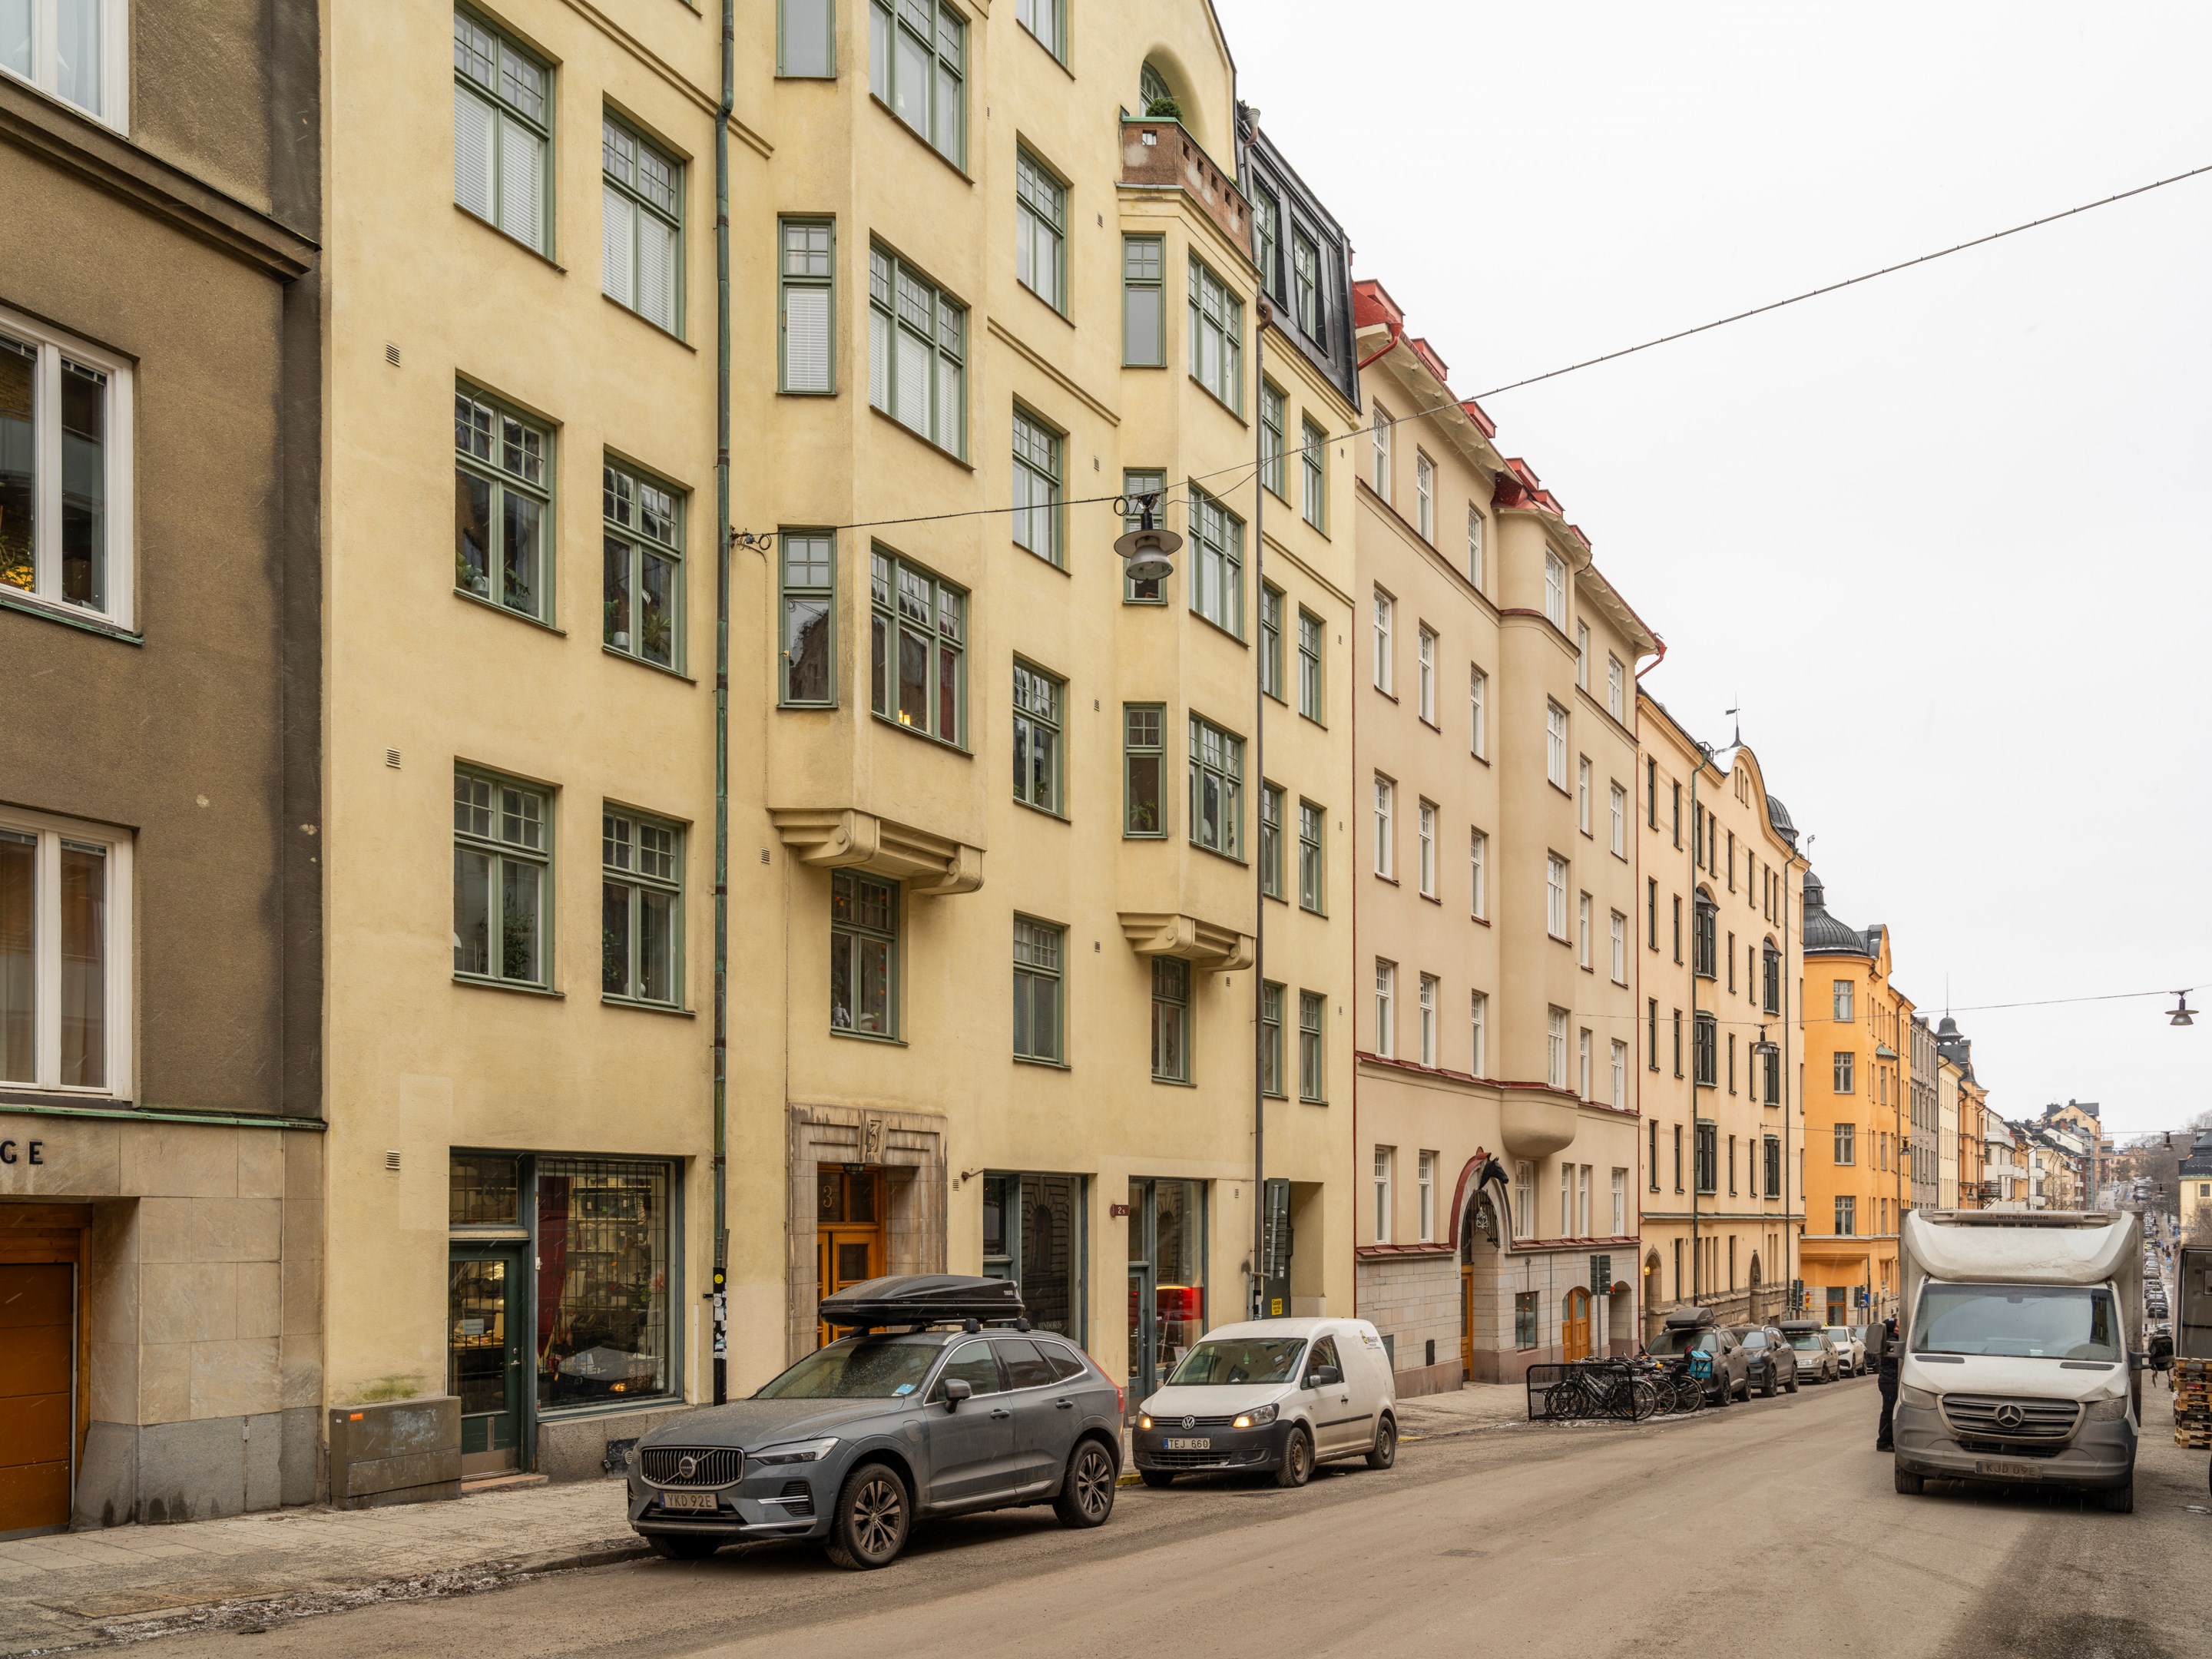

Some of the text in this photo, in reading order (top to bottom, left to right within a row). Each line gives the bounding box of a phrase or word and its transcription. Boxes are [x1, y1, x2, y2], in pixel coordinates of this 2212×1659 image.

[868, 1119, 882, 1153] 3
[0, 1140, 43, 1165] GE
[823, 1185, 833, 1208] 3
[1038, 1320, 1062, 1330] MINDORIS
[1169, 1439, 1208, 1449] TEJ 660
[1986, 1464, 2035, 1476] KJD 09E
[667, 1494, 712, 1508] YKD 92E
